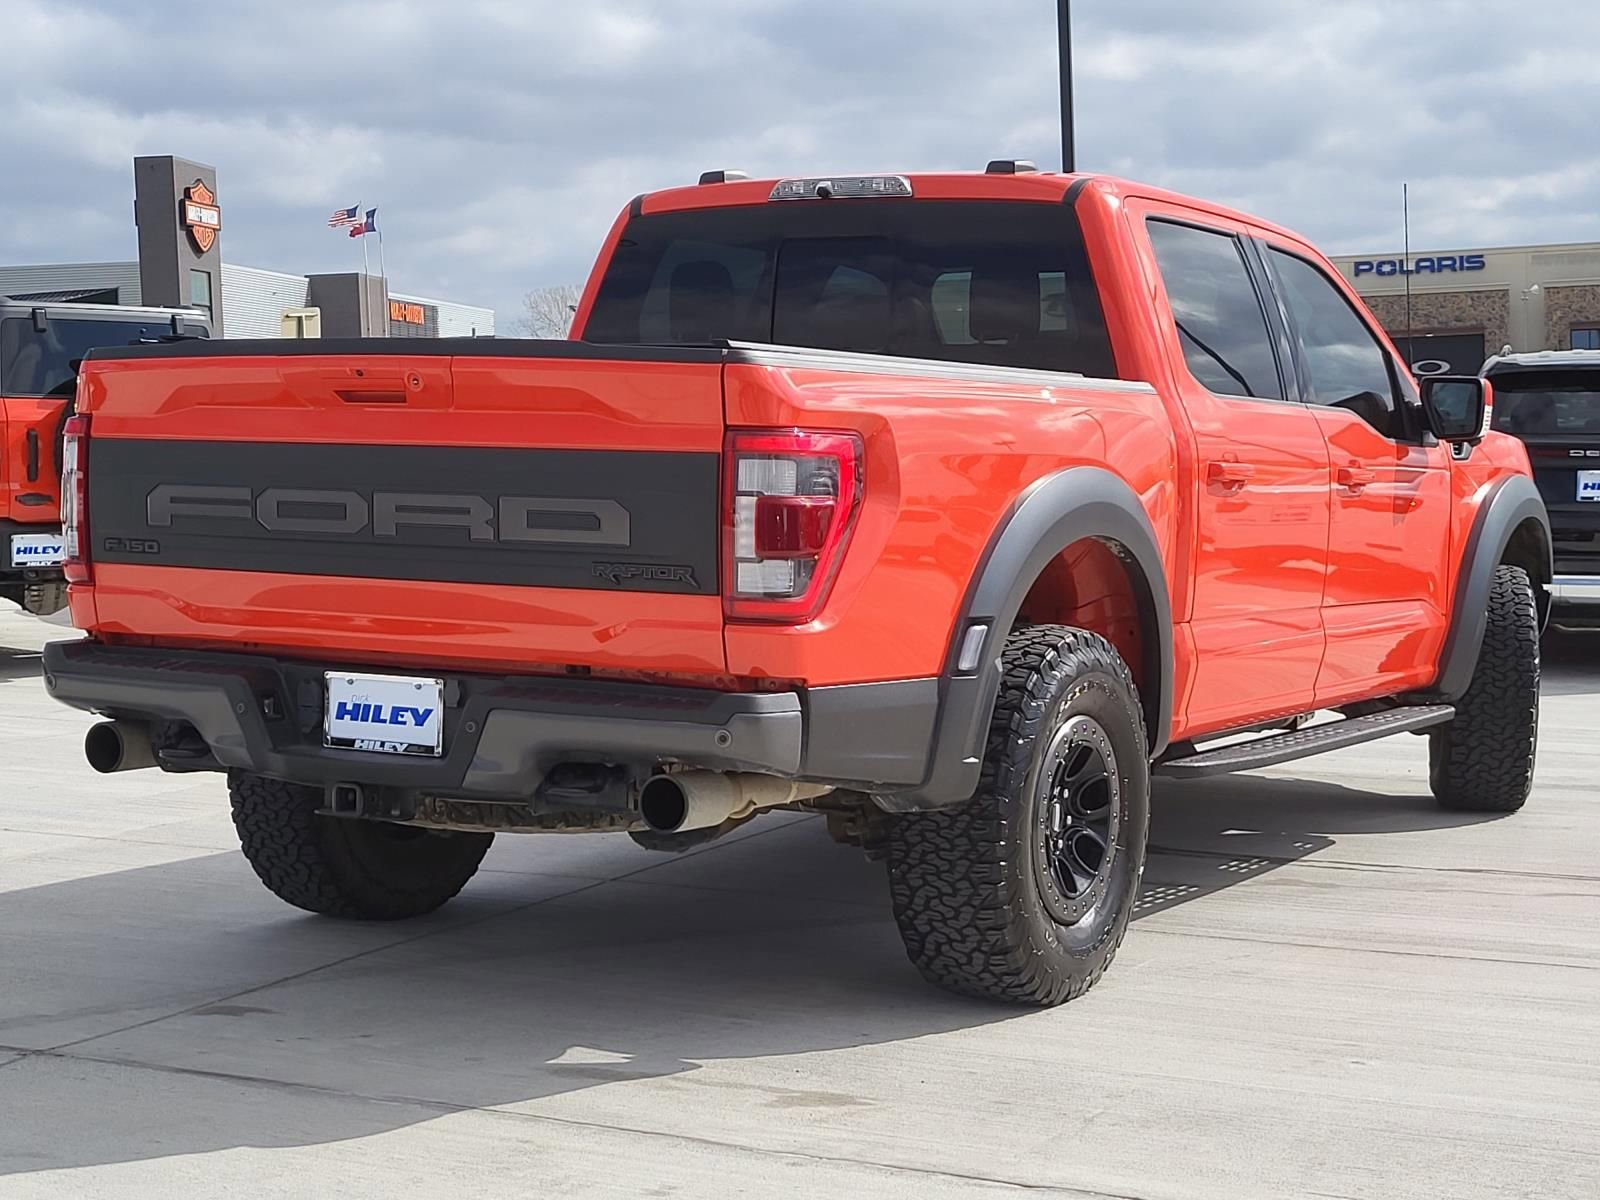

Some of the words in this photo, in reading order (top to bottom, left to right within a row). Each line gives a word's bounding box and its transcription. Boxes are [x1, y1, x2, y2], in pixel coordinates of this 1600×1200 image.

[1353, 254, 1485, 277] POLARIS
[147, 484, 631, 546] FORD
[16, 545, 62, 555] HILEY
[591, 561, 700, 588] RAPTOR
[335, 701, 434, 727] HILEY
[354, 739, 408, 752] HILEY
